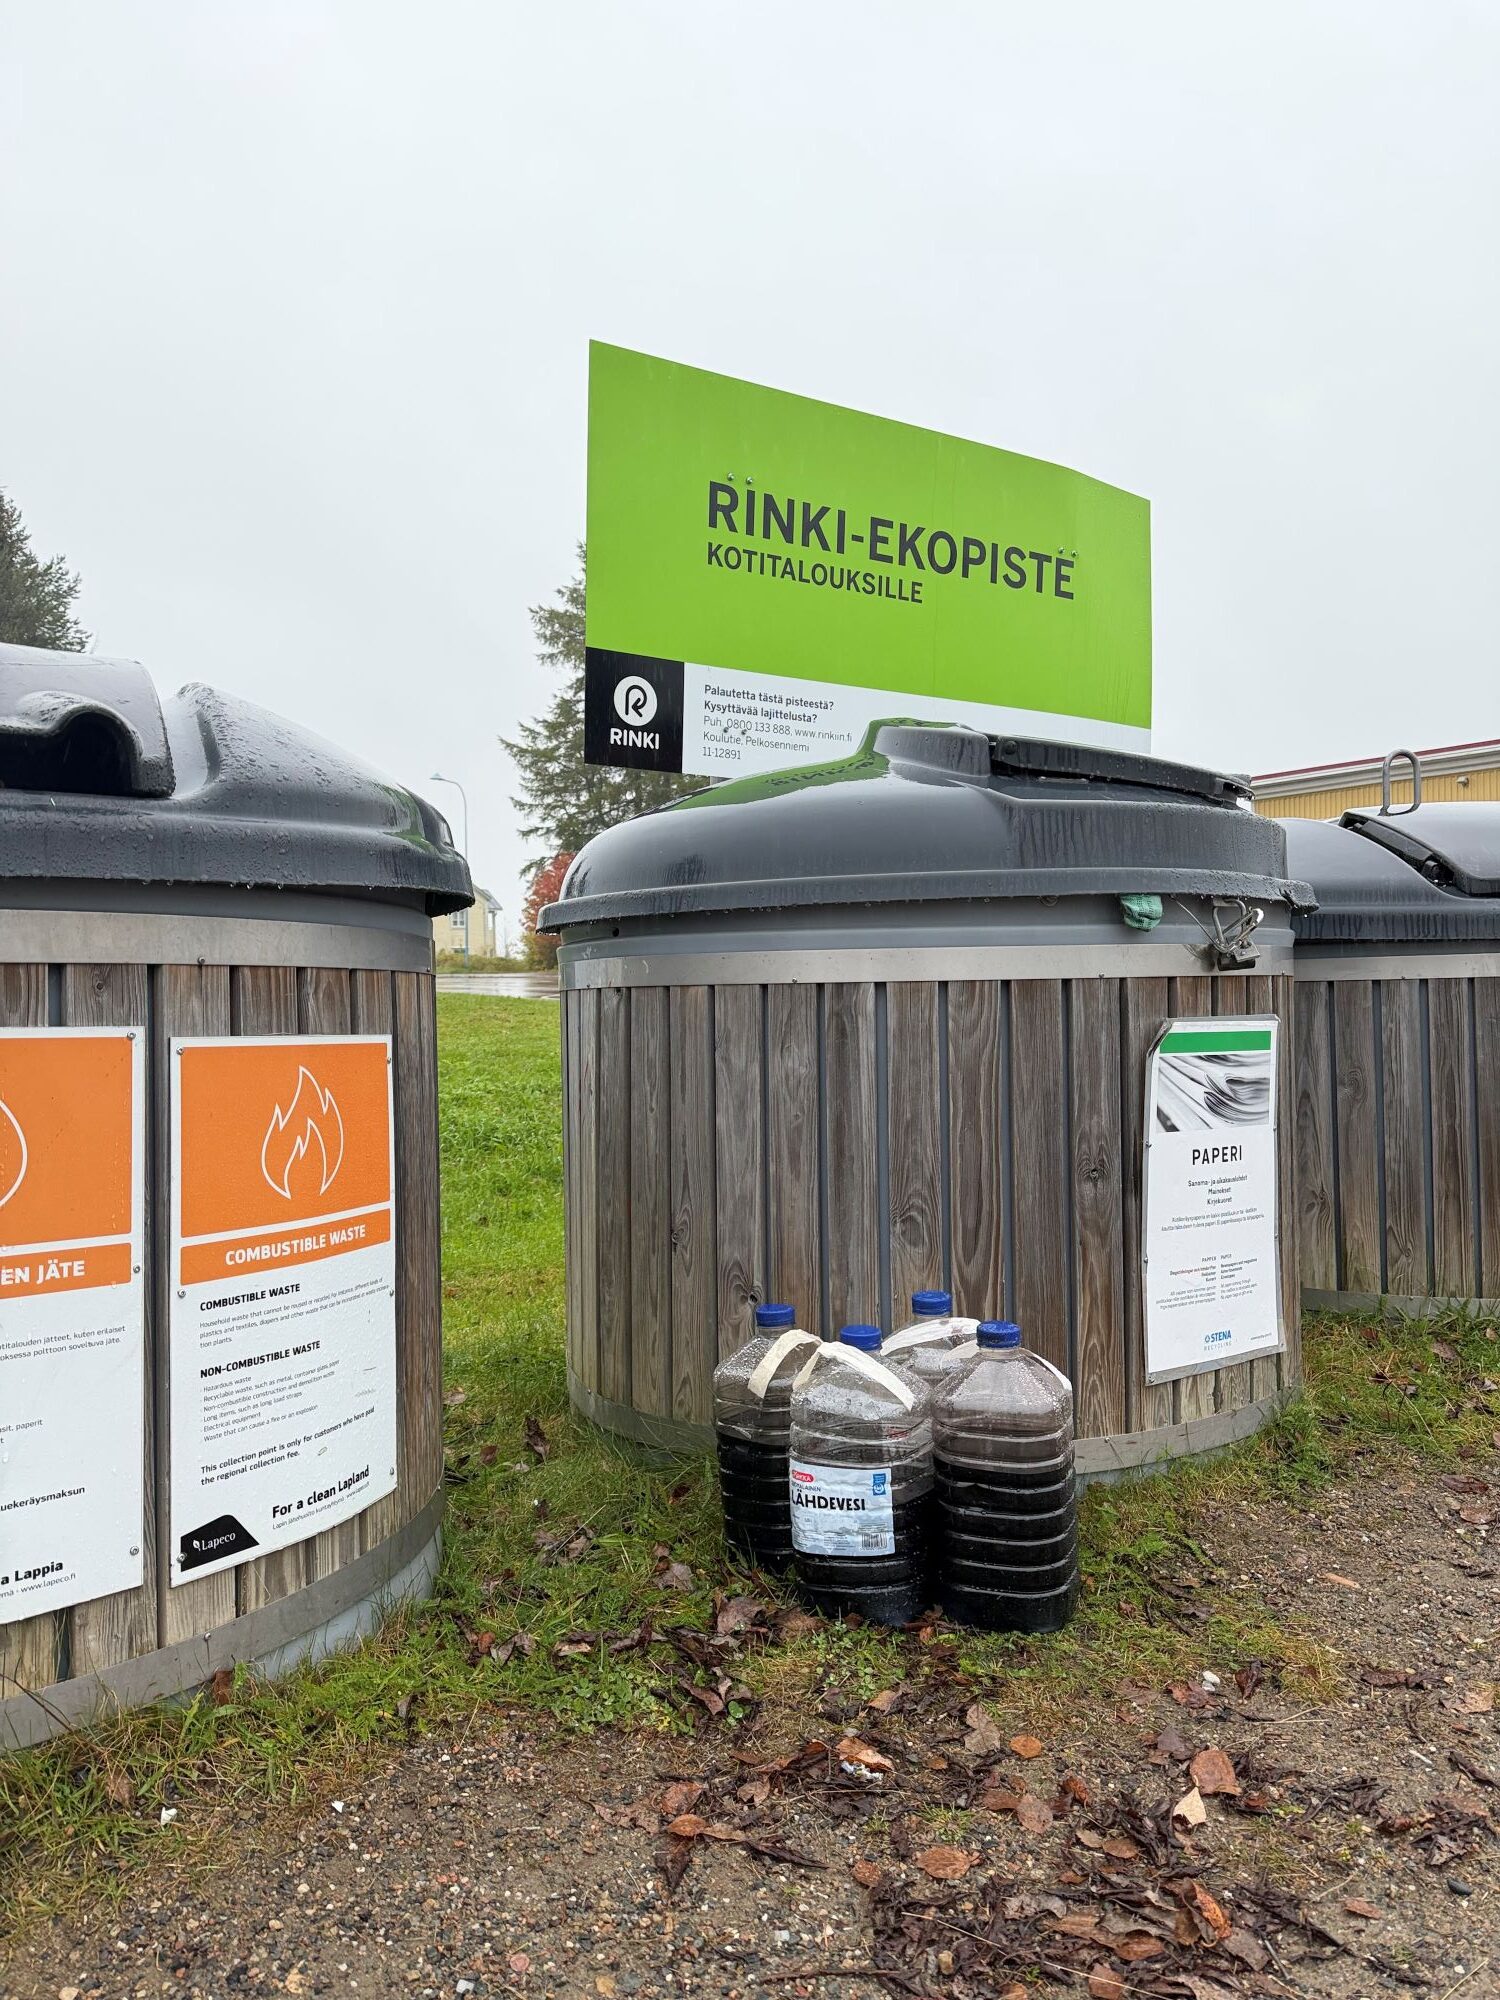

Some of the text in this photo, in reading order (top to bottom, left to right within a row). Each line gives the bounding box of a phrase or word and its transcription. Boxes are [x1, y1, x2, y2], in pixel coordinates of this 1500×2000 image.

[708, 480, 1075, 600] RINKI-EKOPISTE
[707, 542, 923, 604] KOTITALOUKSILLE
[704, 684, 834, 711] Palautetta tästä pisteestä?
[704, 700, 818, 724] Kysyttävää lajittelusta?
[610, 727, 660, 750] RINKI
[703, 731, 810, 752] Koulutie, Pelkosenniemi
[726, 718, 752, 731] 0800
[754, 721, 771, 734] 133
[772, 723, 793, 737] 888,
[794, 727, 853, 743] www.rinkiin.fi
[702, 746, 741, 760] 11-12891
[1191, 1144, 1243, 1166] PAPERI
[225, 1224, 366, 1266] COMBUSTIBLE WASTE
[36, 1258, 85, 1285] JÄTE
[200, 1283, 300, 1311] COMBUSTIBLE WASTE
[200, 1317, 231, 1328] Household
[249, 1310, 262, 1319] that
[263, 1306, 282, 1315] cannot
[73, 1331, 95, 1339] kuten
[96, 1325, 126, 1336] erilaiset
[199, 1329, 223, 1340] plastics
[223, 1325, 235, 1333] and
[259, 1317, 279, 1326] diapers
[1210, 1329, 1232, 1343] STENA
[33, 1345, 67, 1357] polttoon
[68, 1340, 104, 1351] soveltuva
[200, 1341, 212, 1349] tion
[200, 1340, 321, 1378] NON-COMBUSTIBLE WASTE
[203, 1376, 252, 1392] Hazardous waste
[203, 1390, 234, 1402] Recyclable
[254, 1381, 268, 1390] such
[203, 1395, 252, 1412] Non-combustible
[252, 1386, 287, 1400] construction
[203, 1414, 218, 1423] Long
[237, 1405, 252, 1413] such
[251, 1402, 259, 1410] as
[203, 1411, 261, 1432] Electrical equipment
[15, 1418, 43, 1432] paperit
[203, 1432, 222, 1442] Waste
[223, 1428, 236, 1436] that
[237, 1425, 248, 1433] can
[248, 1420, 265, 1429] cause
[200, 1405, 375, 1474] This collection point is only for customers who have paid
[200, 1450, 301, 1486] the regional collection fee.
[272, 1464, 370, 1519] For a clean Lapland
[791, 1488, 866, 1511] LÄHDEVESI
[272, 1520, 288, 1530] Lapin
[202, 1532, 236, 1551] Lapeco
[14, 1561, 64, 1582] Lappia
[20, 1573, 76, 1593] www.lapeco.fi
